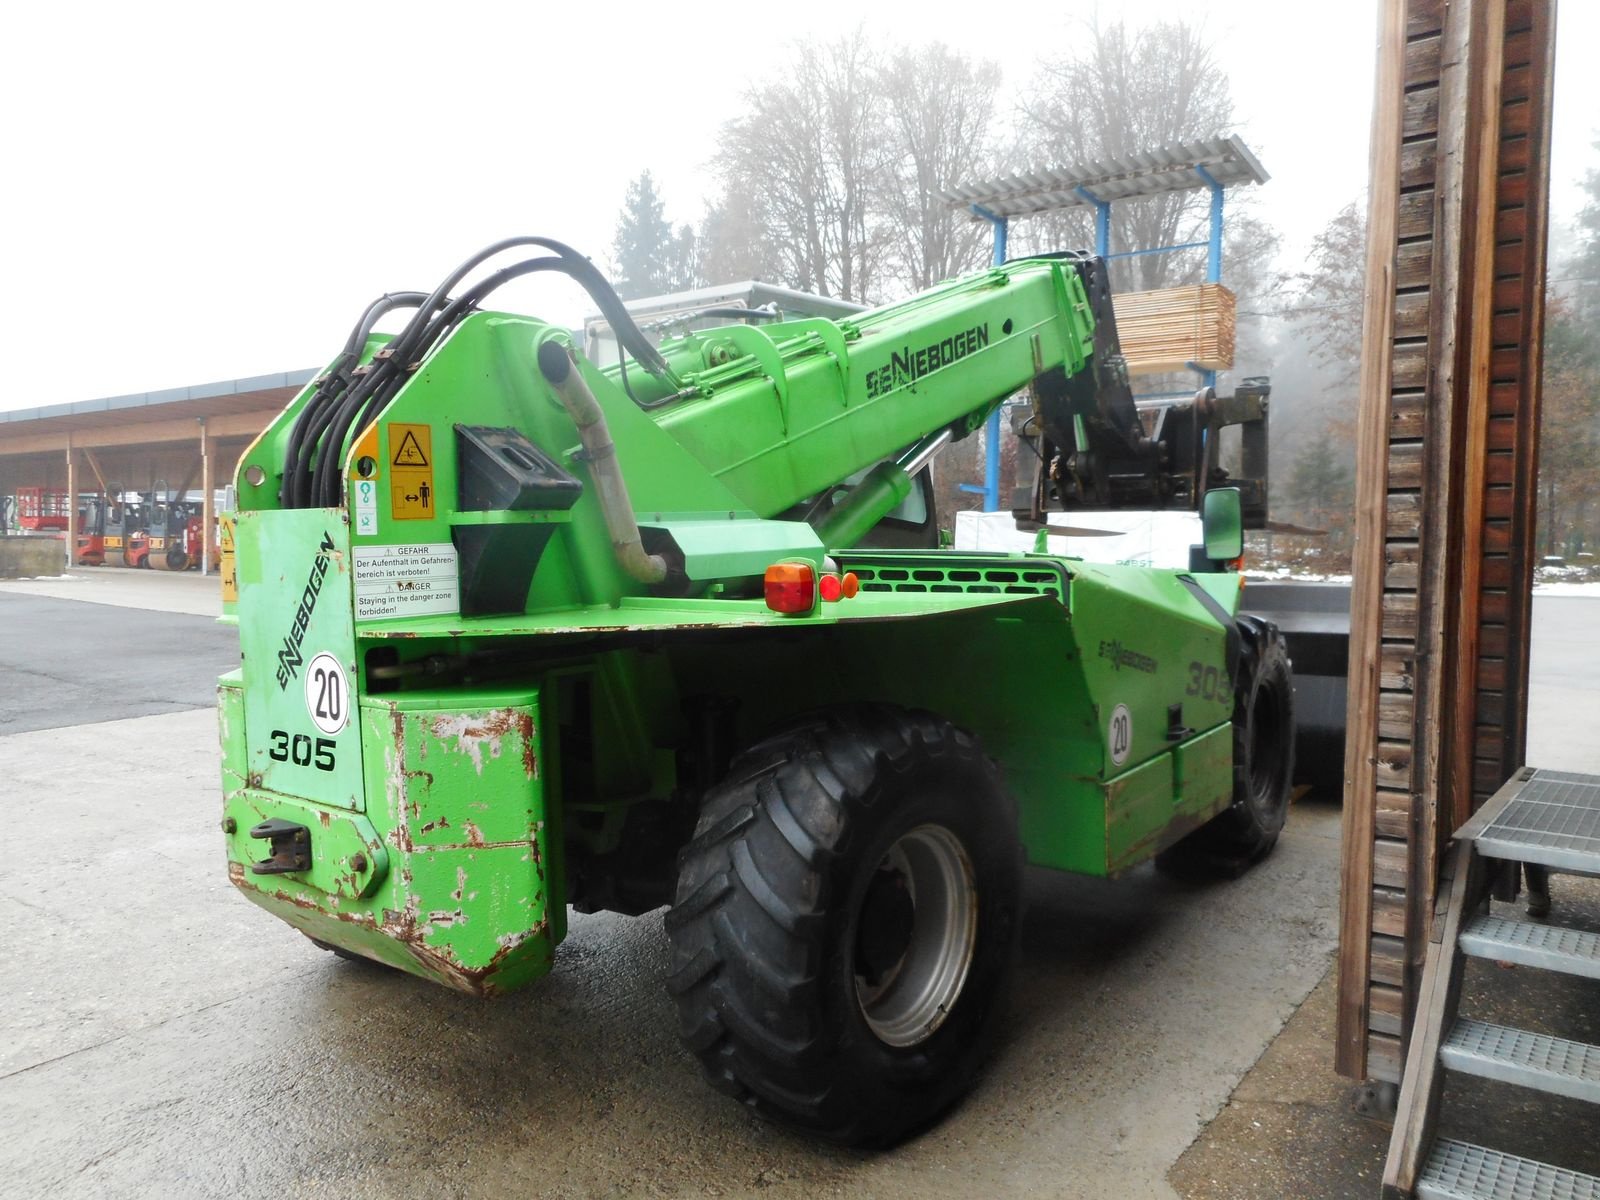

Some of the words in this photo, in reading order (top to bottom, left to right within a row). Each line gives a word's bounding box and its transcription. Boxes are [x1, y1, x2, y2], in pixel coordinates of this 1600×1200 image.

[397, 547, 429, 555] GEFAHR
[356, 560, 370, 568] Der
[371, 558, 409, 567] Aufenthalt
[420, 557, 454, 565] Gefahren-
[357, 570, 385, 578] bereich
[386, 569, 396, 577] ist
[397, 568, 430, 576] verboten!
[398, 582, 431, 592] DANGER
[359, 595, 387, 606] Staying
[388, 595, 396, 603] in
[397, 594, 408, 602] the
[410, 593, 434, 603] danger
[359, 606, 397, 616] forbidden!
[1186, 661, 1232, 704] 305
[314, 667, 341, 721] 20
[1113, 714, 1128, 755] 20
[269, 730, 337, 772] 305
